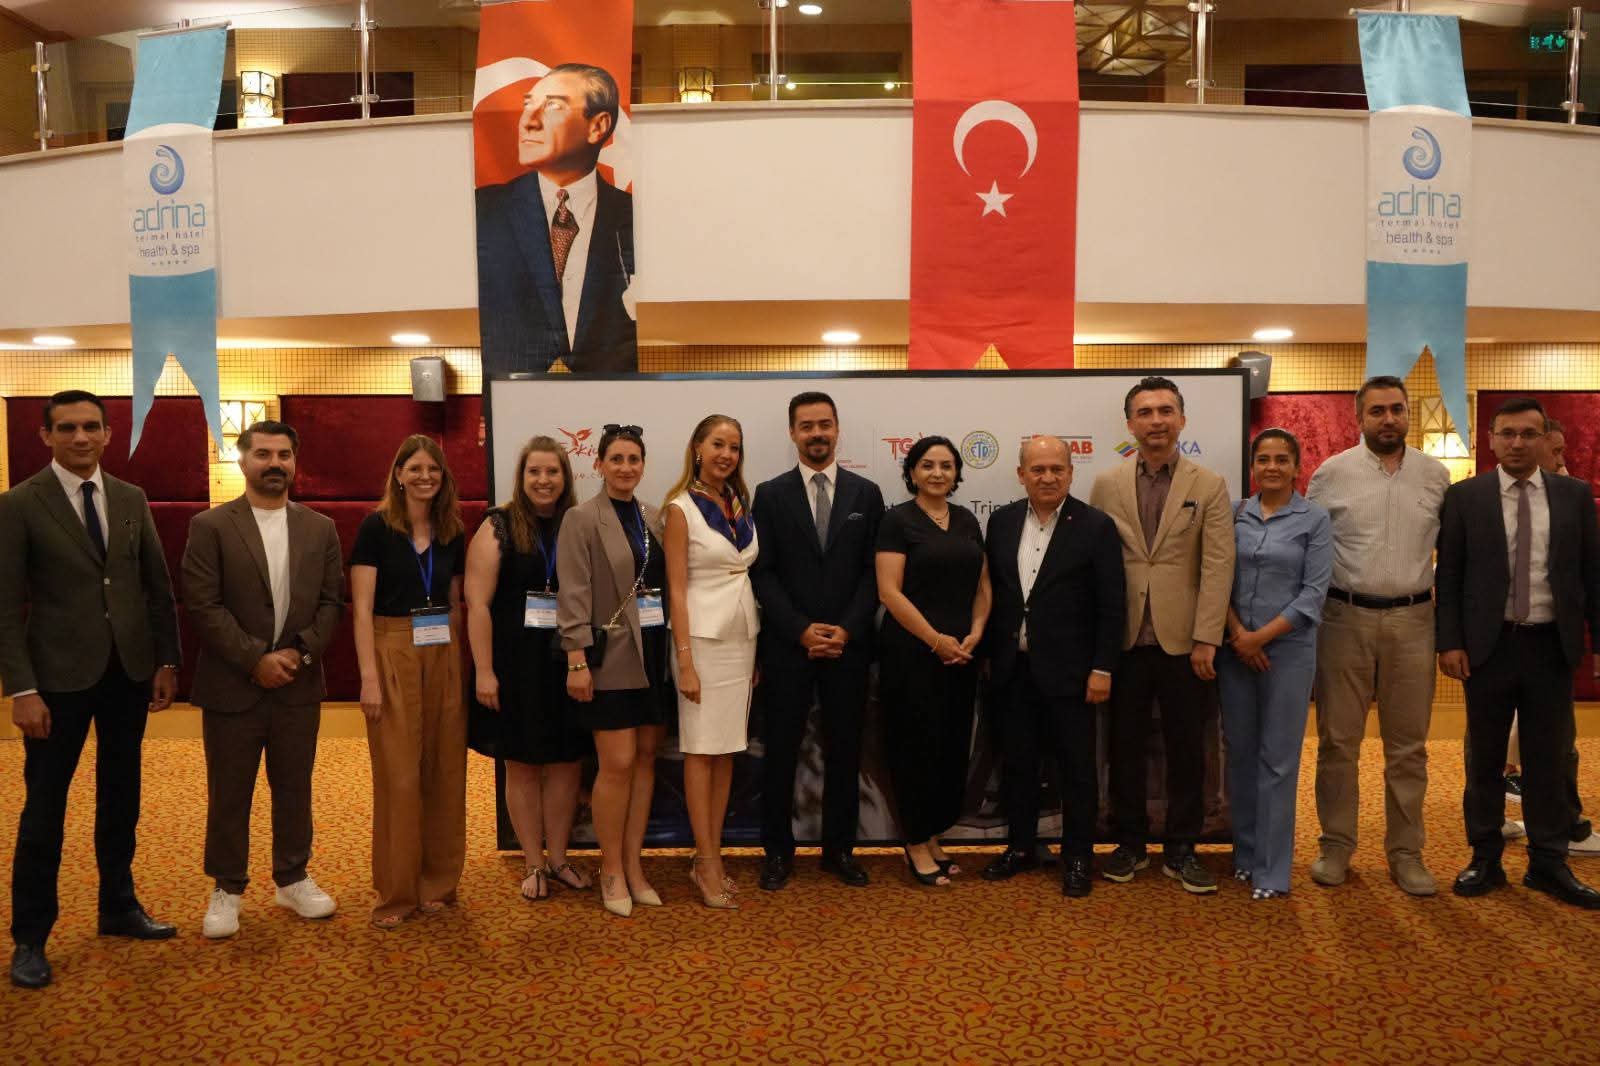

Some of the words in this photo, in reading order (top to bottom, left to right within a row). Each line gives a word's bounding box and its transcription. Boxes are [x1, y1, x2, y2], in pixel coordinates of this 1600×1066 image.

[1377, 184, 1461, 218] adrina
[133, 199, 205, 232] adrina
[1386, 231, 1422, 244] health
[1426, 231, 1433, 243] &
[1436, 234, 1453, 245] spa
[139, 246, 168, 257] health
[171, 244, 179, 255] &
[181, 244, 200, 256] spa
